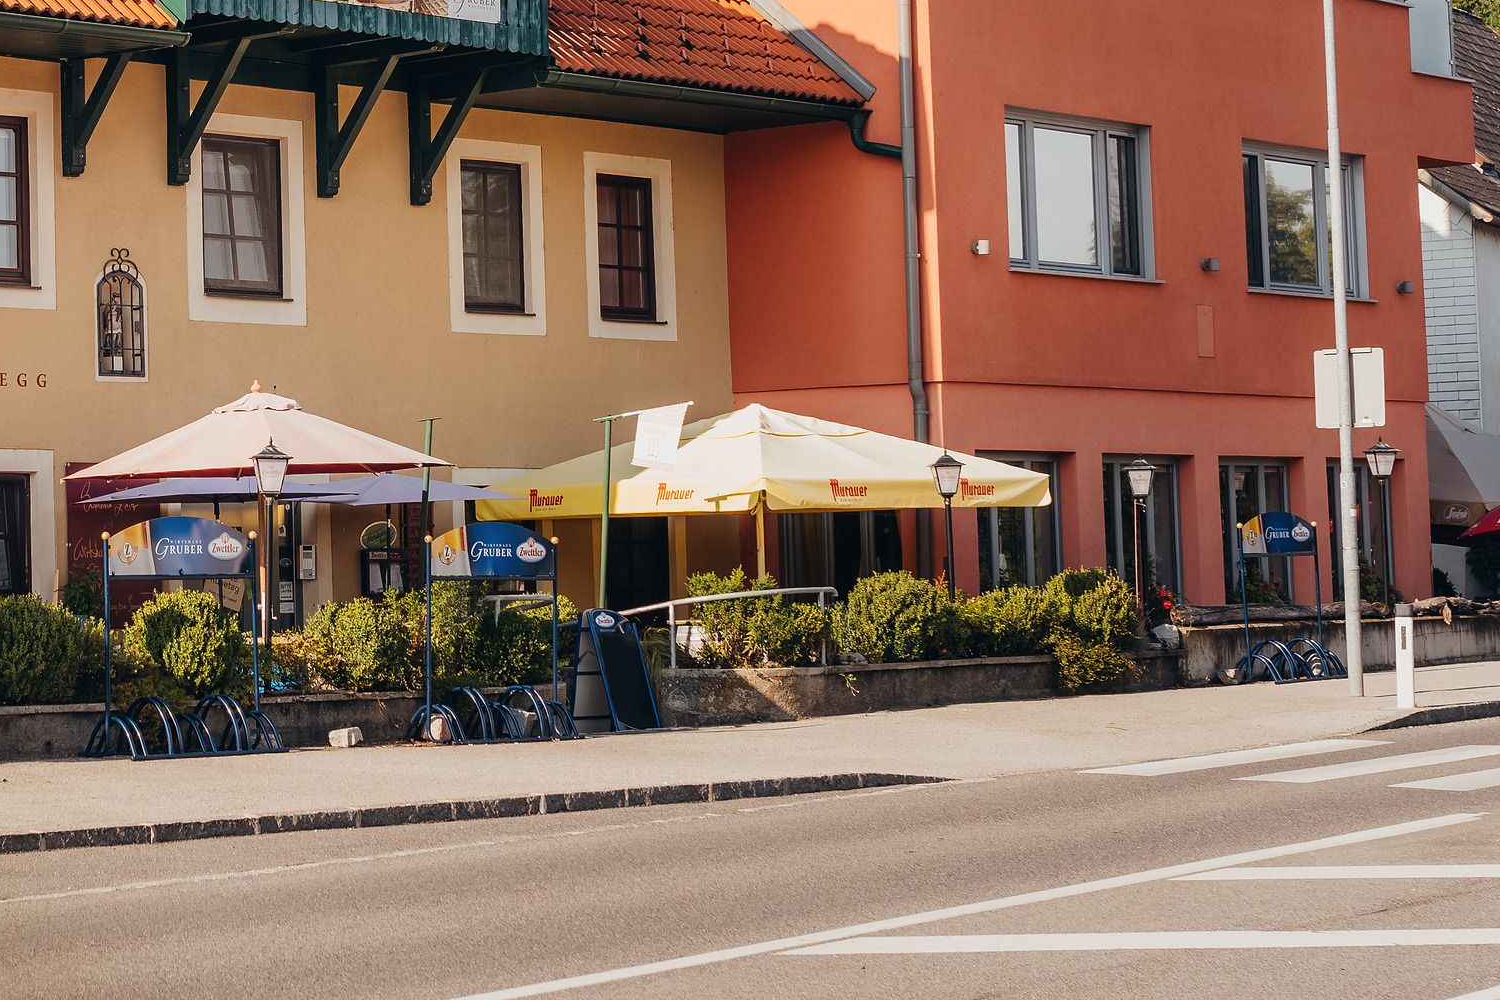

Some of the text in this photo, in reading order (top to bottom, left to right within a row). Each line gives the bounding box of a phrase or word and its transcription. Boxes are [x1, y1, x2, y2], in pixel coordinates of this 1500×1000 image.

[529, 488, 564, 513] Murauer
[655, 482, 695, 506] Murauer
[828, 478, 868, 503] Murauer
[959, 477, 995, 502] Murauer
[1265, 526, 1290, 543] GRUBER
[155, 537, 203, 561] GRUBER
[211, 542, 240, 554] Zwettler
[470, 541, 513, 562] GRUBER
[519, 547, 544, 557] Zwettler
